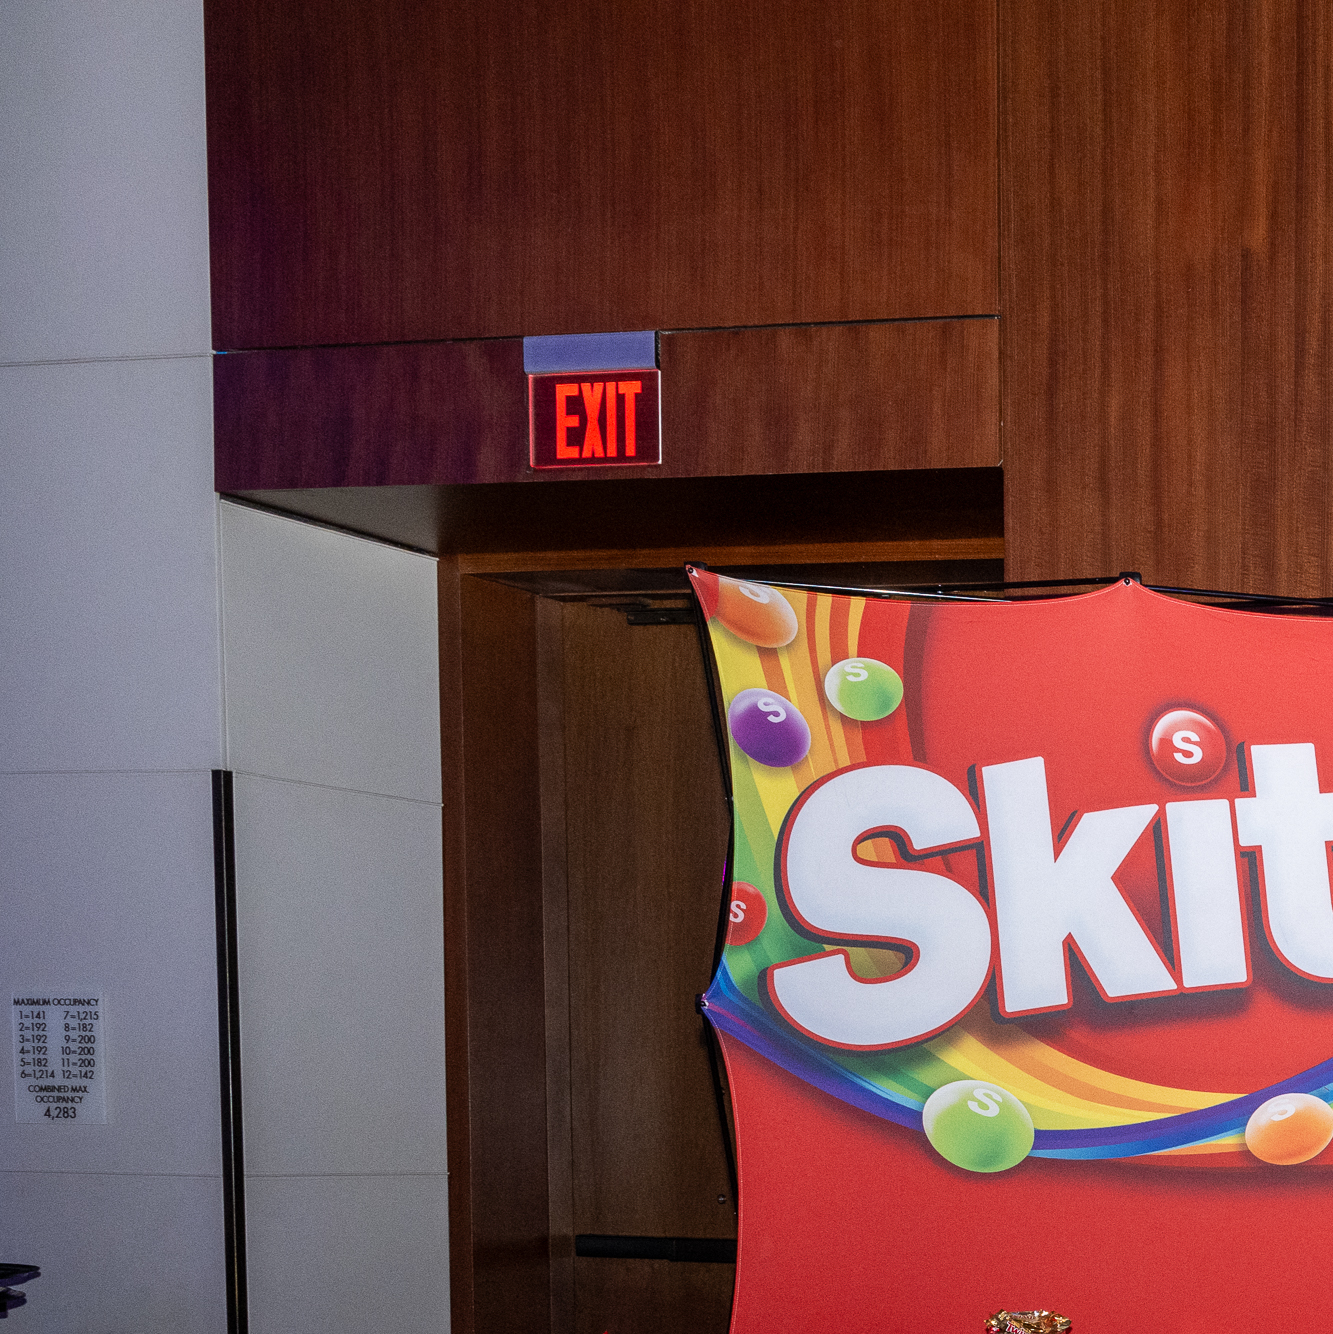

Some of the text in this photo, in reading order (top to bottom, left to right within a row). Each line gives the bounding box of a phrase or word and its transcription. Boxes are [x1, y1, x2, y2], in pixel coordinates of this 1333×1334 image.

[556, 381, 642, 459] EXIT
[844, 662, 870, 683] S
[757, 696, 787, 724] S
[1171, 729, 1204, 765] S
[13, 998, 99, 1006] MAXIMUM OCCUPANCY
[19, 1011, 99, 1021] 1=141 7=1,215
[18, 1023, 94, 1032] 2=192 8=182
[19, 1035, 96, 1044] 3=192 9=200
[19, 1046, 95, 1056] 4=192 10=200
[20, 1058, 95, 1068] 5=182 11=200
[20, 1070, 94, 1081] 6=1,214 12=142
[28, 1085, 69, 1093] COMBINED
[35, 1095, 83, 1104] OCCUPANCY
[969, 1087, 1003, 1118] S
[44, 1106, 77, 1120] 4,283
